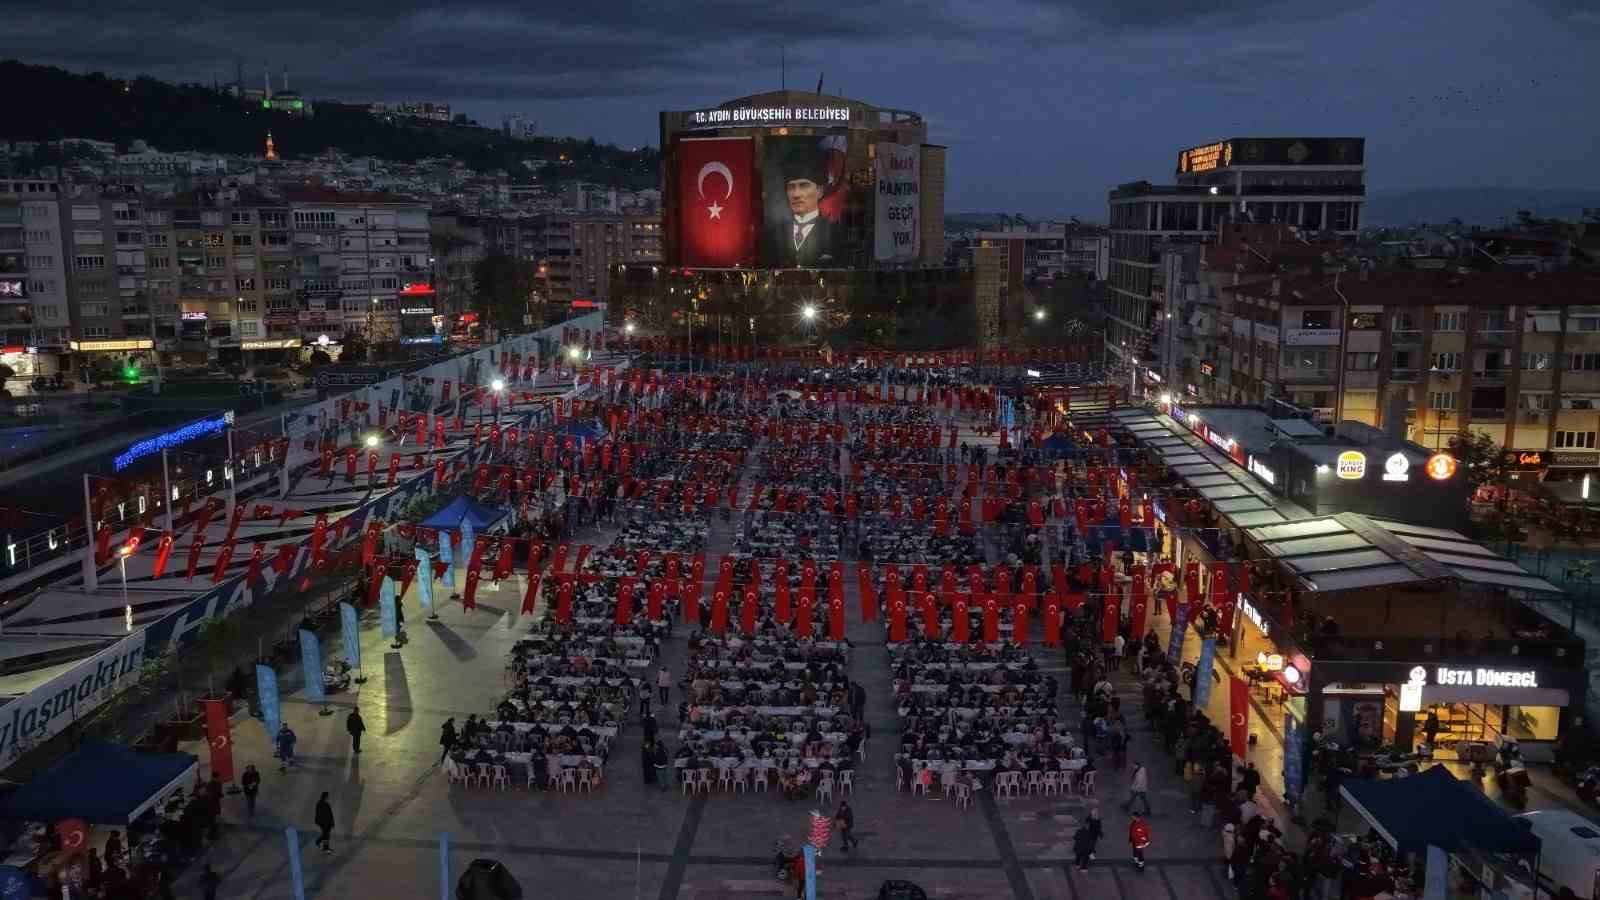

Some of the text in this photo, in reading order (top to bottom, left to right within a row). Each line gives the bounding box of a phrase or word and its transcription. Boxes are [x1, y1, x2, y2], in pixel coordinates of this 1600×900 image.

[695, 105, 850, 123] T.C. AYDIN BÜYÜKŞEHİR BELEDİYESİ
[1437, 667, 1538, 688] USTA DÖNERCİ
